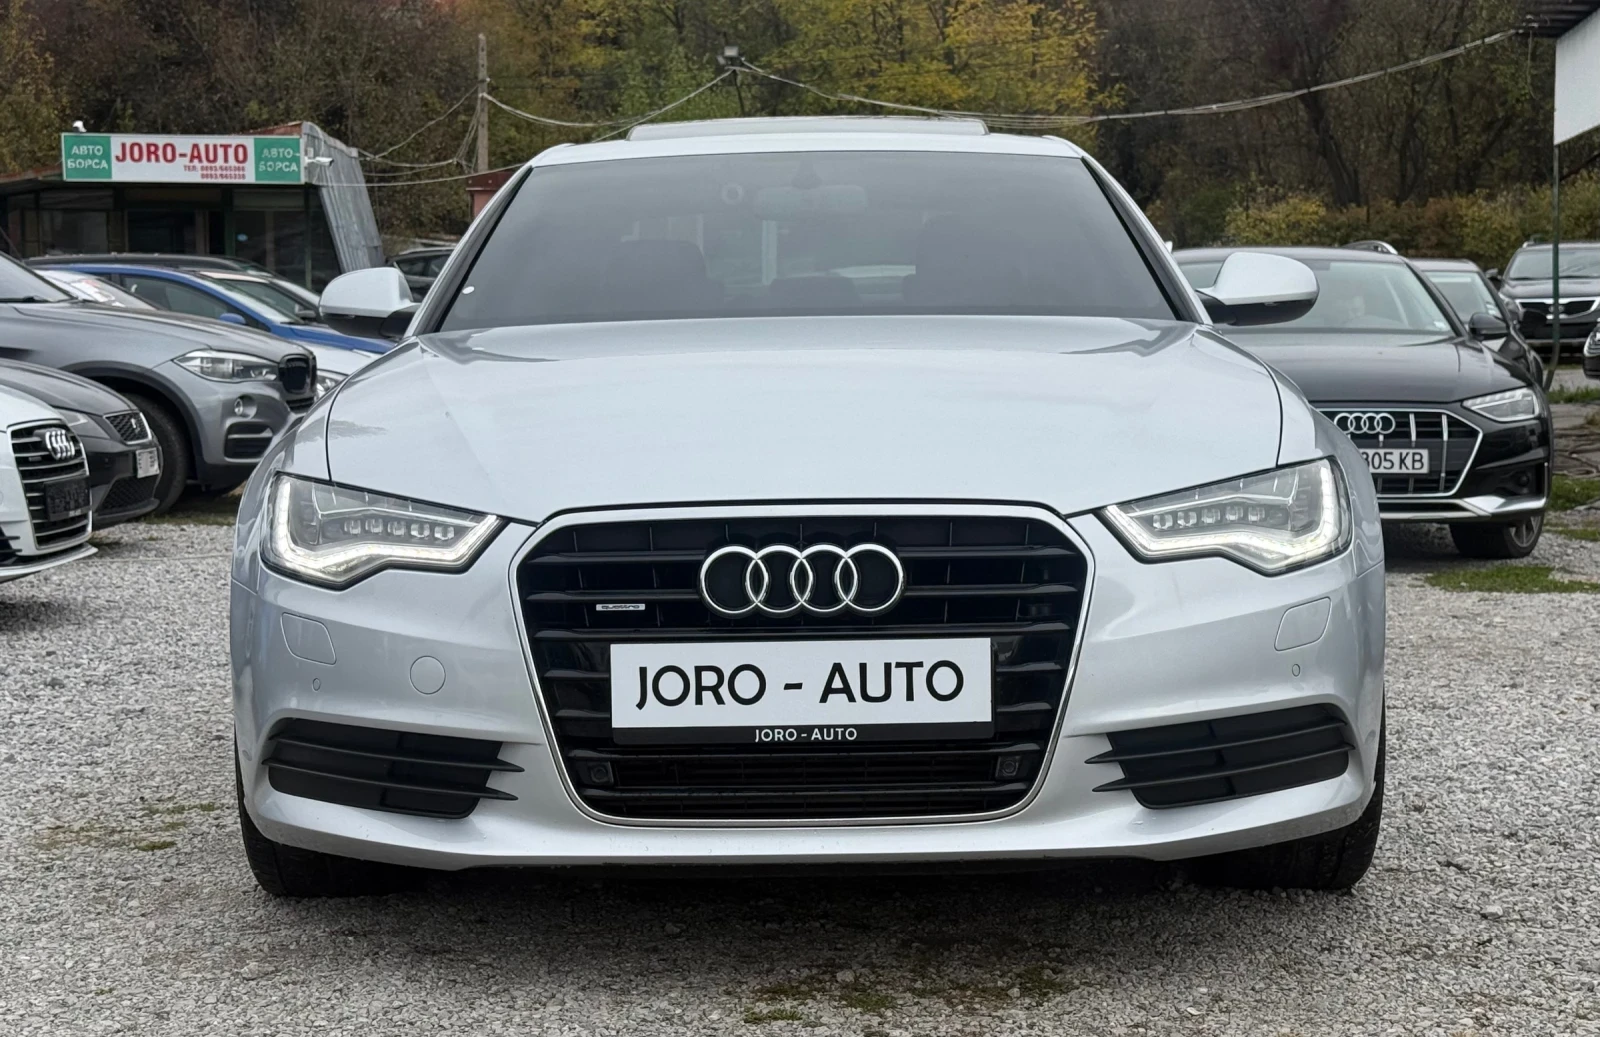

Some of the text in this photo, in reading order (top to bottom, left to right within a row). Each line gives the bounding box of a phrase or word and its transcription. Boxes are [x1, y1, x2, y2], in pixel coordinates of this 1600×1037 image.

[71, 145, 103, 156] АВТО
[115, 142, 249, 165] JORO-AUTO
[67, 158, 109, 170] БОРСА
[258, 160, 299, 172] БОРСА
[1399, 451, 1424, 470] KB
[635, 659, 965, 711] JORO - AUTO
[754, 729, 797, 743] JORO
[811, 728, 858, 741] AUTO
